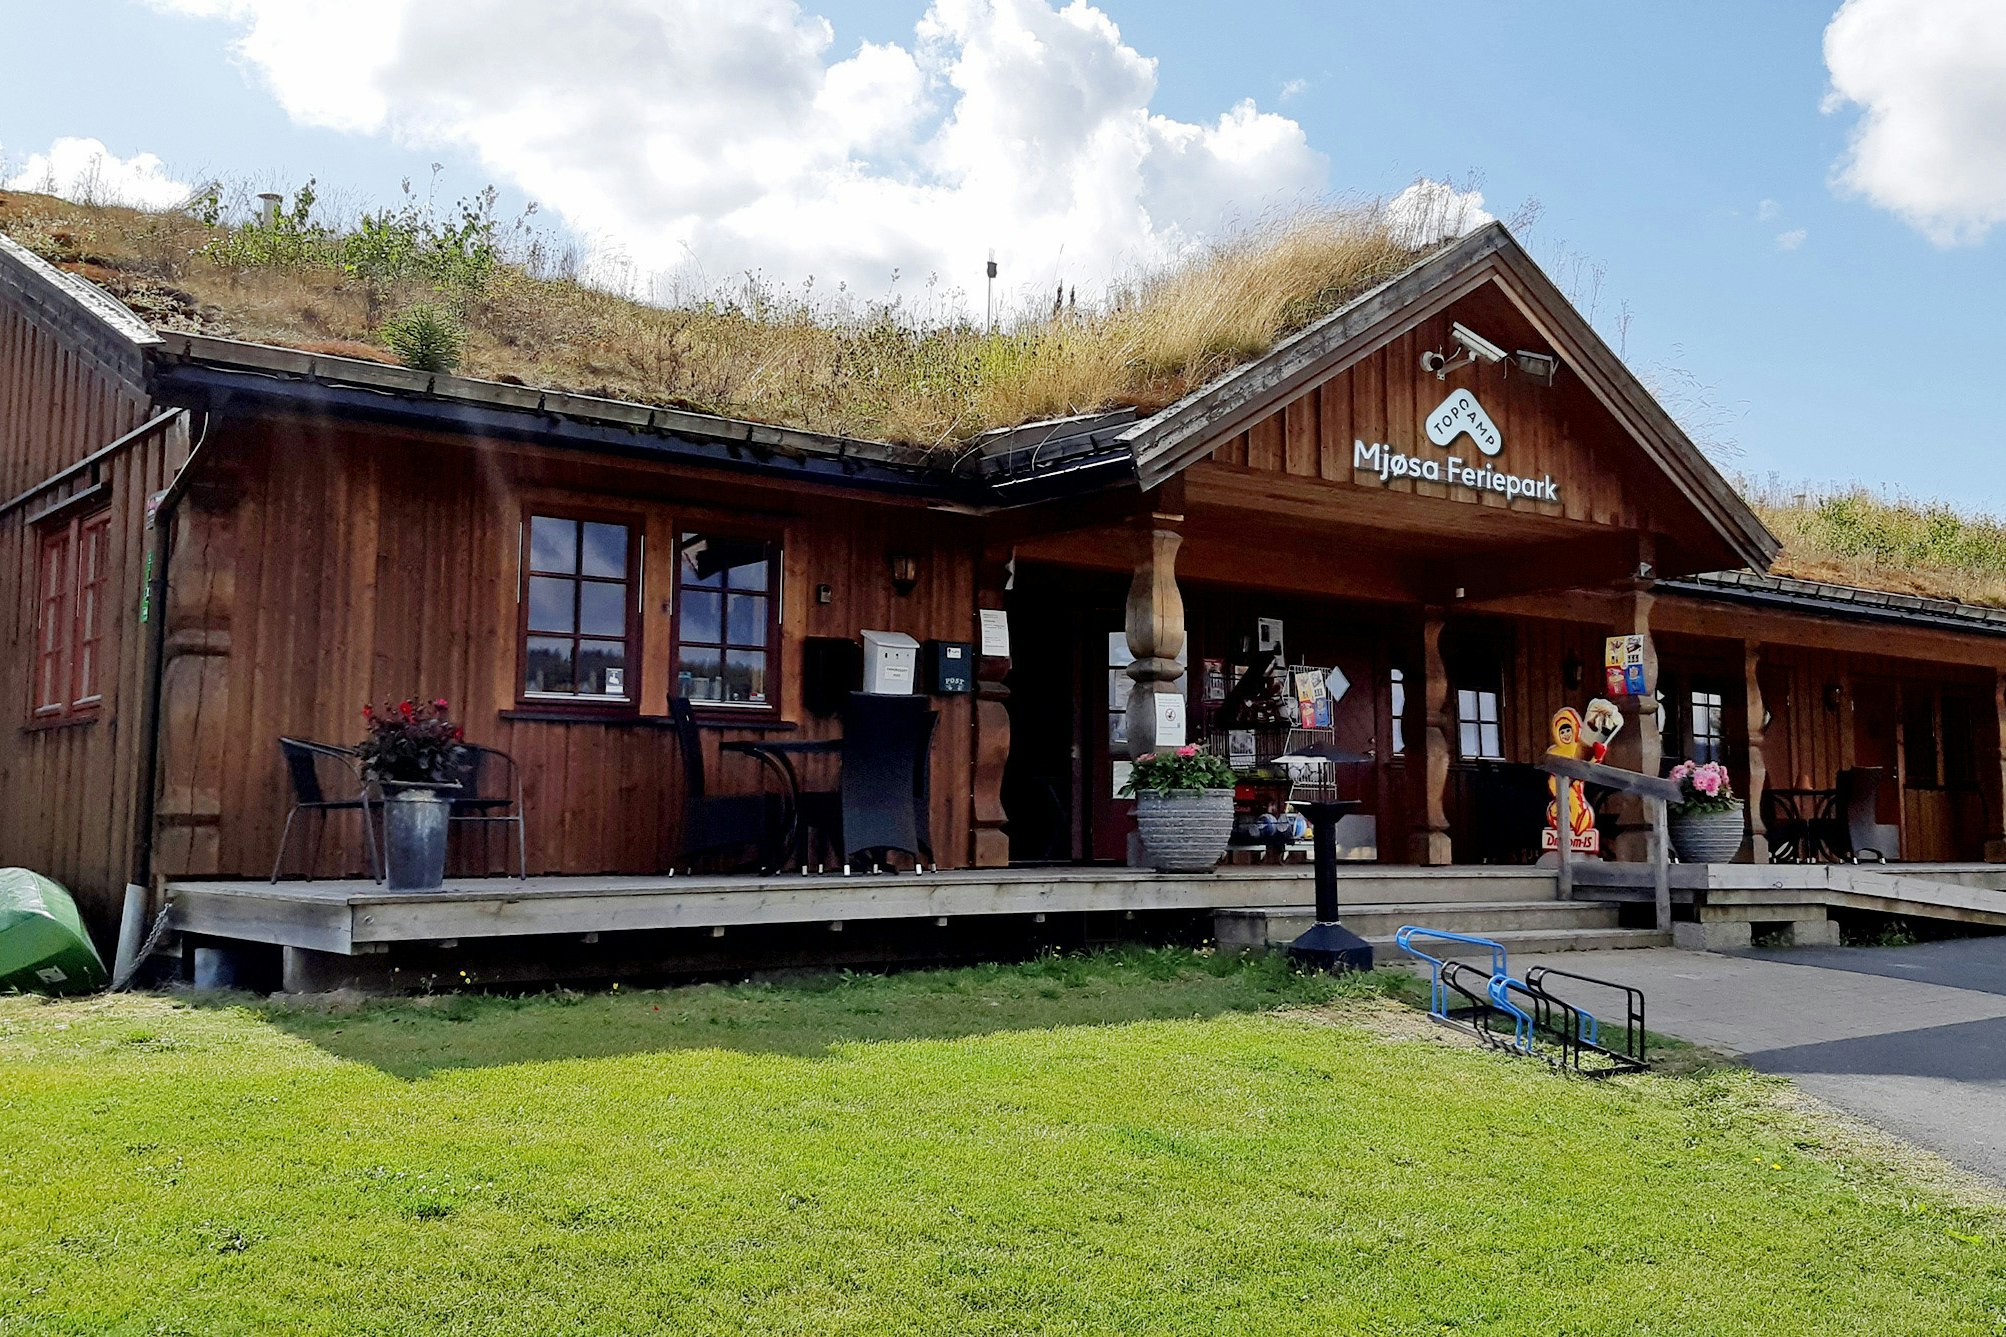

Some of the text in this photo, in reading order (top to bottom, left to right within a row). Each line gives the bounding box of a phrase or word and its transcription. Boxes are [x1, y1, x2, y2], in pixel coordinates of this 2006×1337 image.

[1433, 398, 1495, 445] TOPCAMP
[1353, 439, 1557, 500] Mjøsa Feriepark
[945, 677, 965, 685] POST
